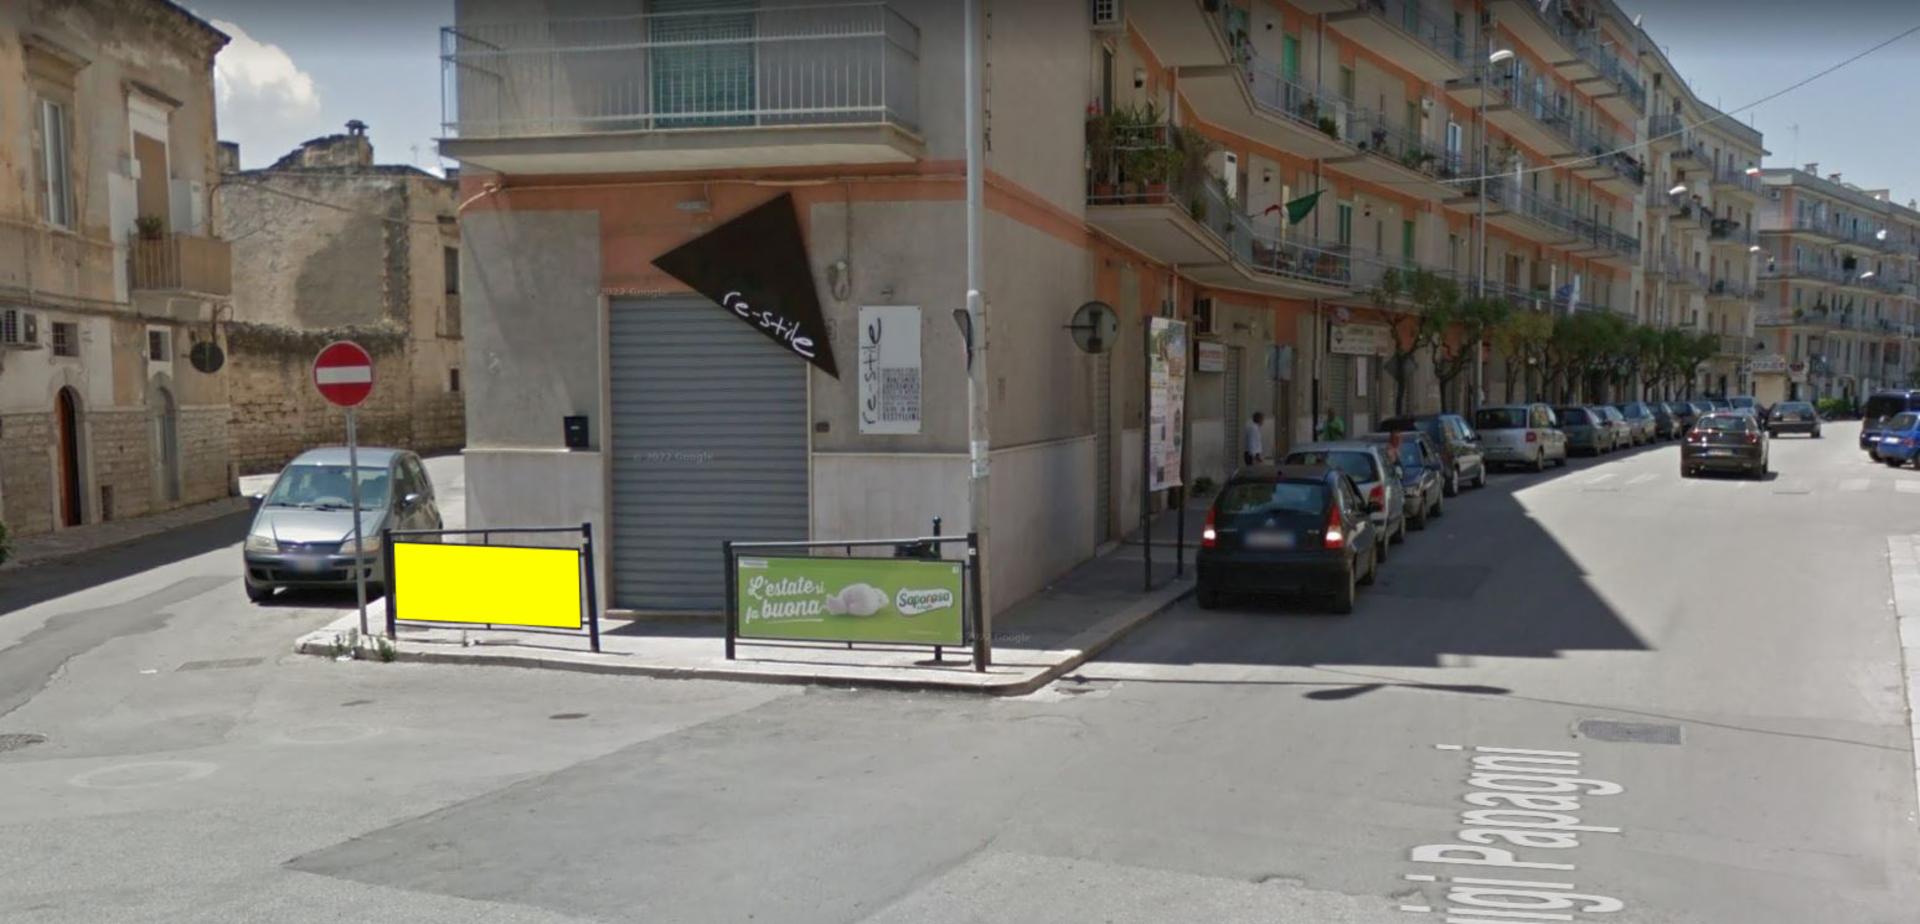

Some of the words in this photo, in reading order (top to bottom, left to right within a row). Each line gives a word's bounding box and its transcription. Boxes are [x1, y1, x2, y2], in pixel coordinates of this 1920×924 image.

[723, 292, 815, 357] re-stile
[861, 317, 881, 424] re-stile
[748, 576, 815, 600] L'estate
[762, 600, 823, 618] buona
